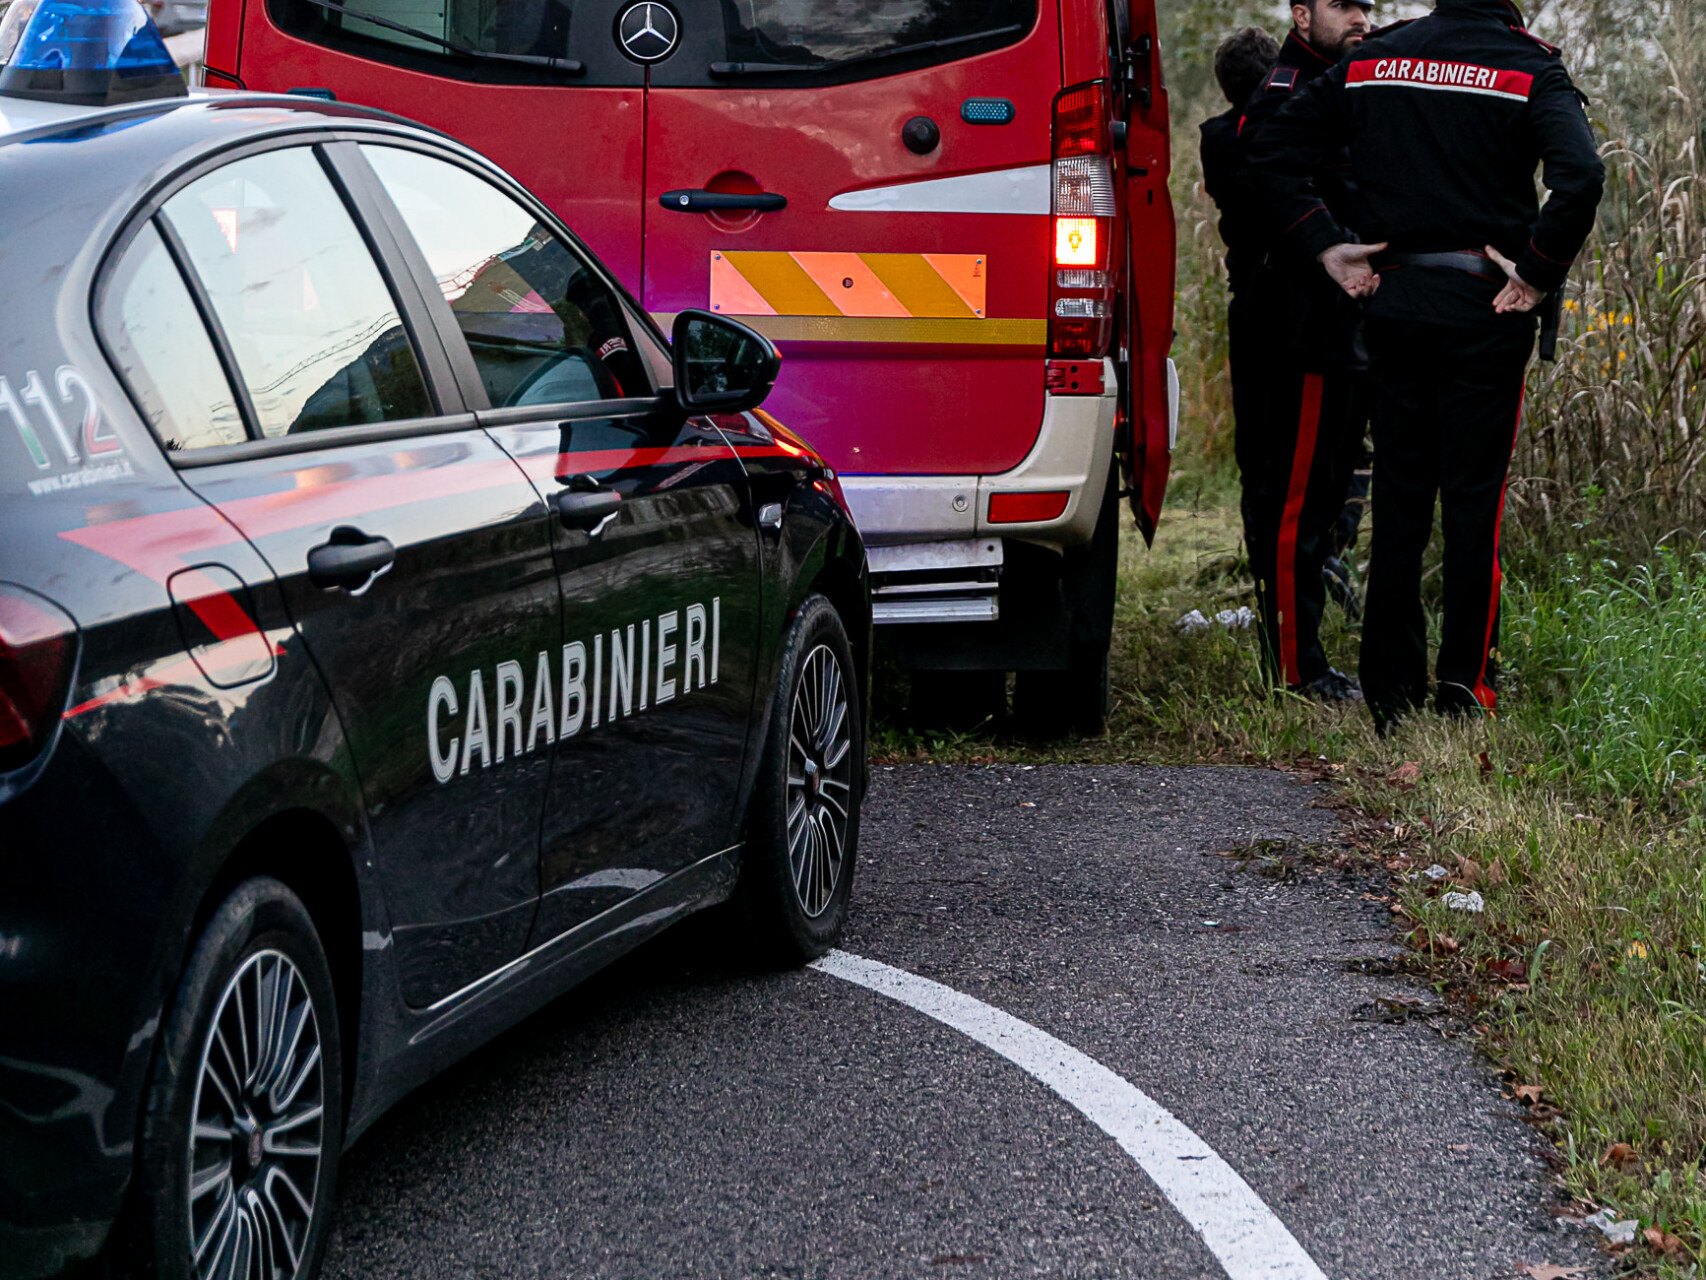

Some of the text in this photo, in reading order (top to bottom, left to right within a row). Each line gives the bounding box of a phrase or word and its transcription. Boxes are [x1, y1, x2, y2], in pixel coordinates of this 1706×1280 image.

[1374, 59, 1498, 88] CARABINIERI
[0, 365, 122, 469] 112
[427, 596, 720, 784] CARABINIERI
